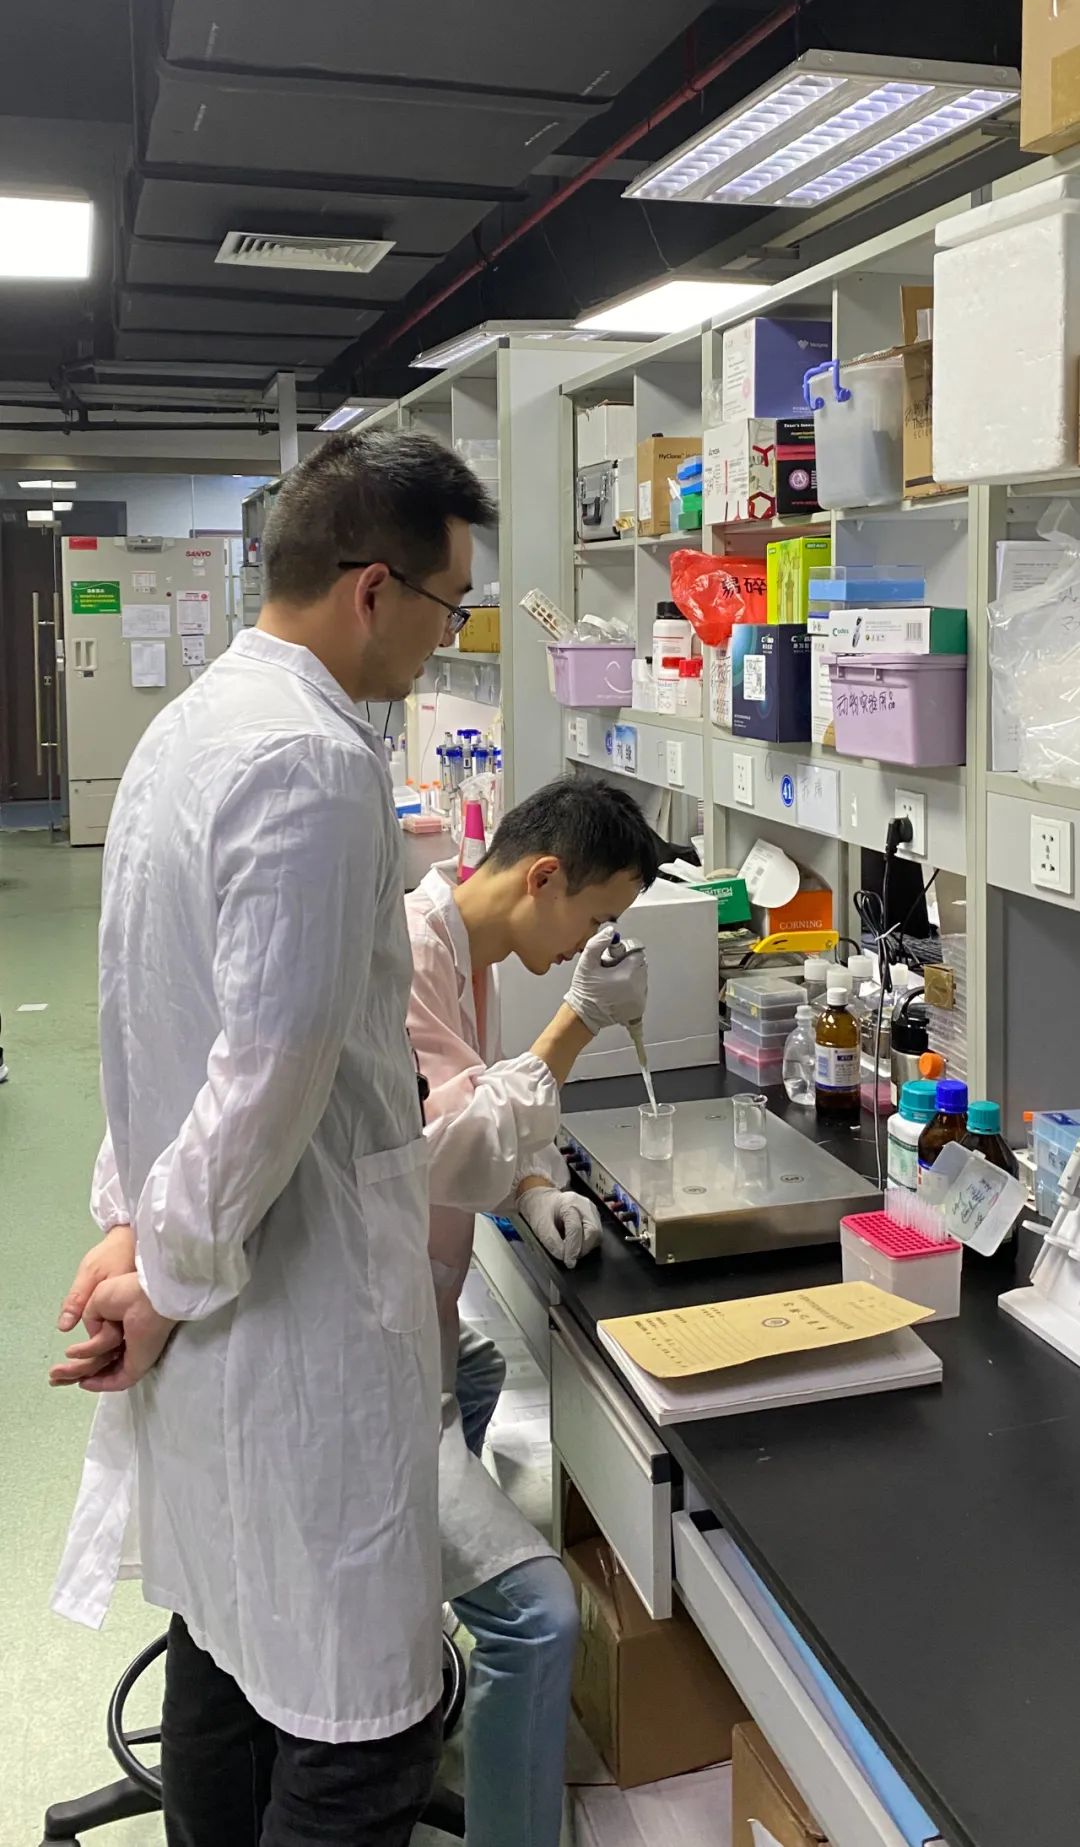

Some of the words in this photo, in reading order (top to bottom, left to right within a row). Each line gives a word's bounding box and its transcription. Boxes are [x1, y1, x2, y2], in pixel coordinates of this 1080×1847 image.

[185, 550, 212, 558] SANYO
[782, 782, 793, 800] 41
[779, 919, 823, 930] CORNING
